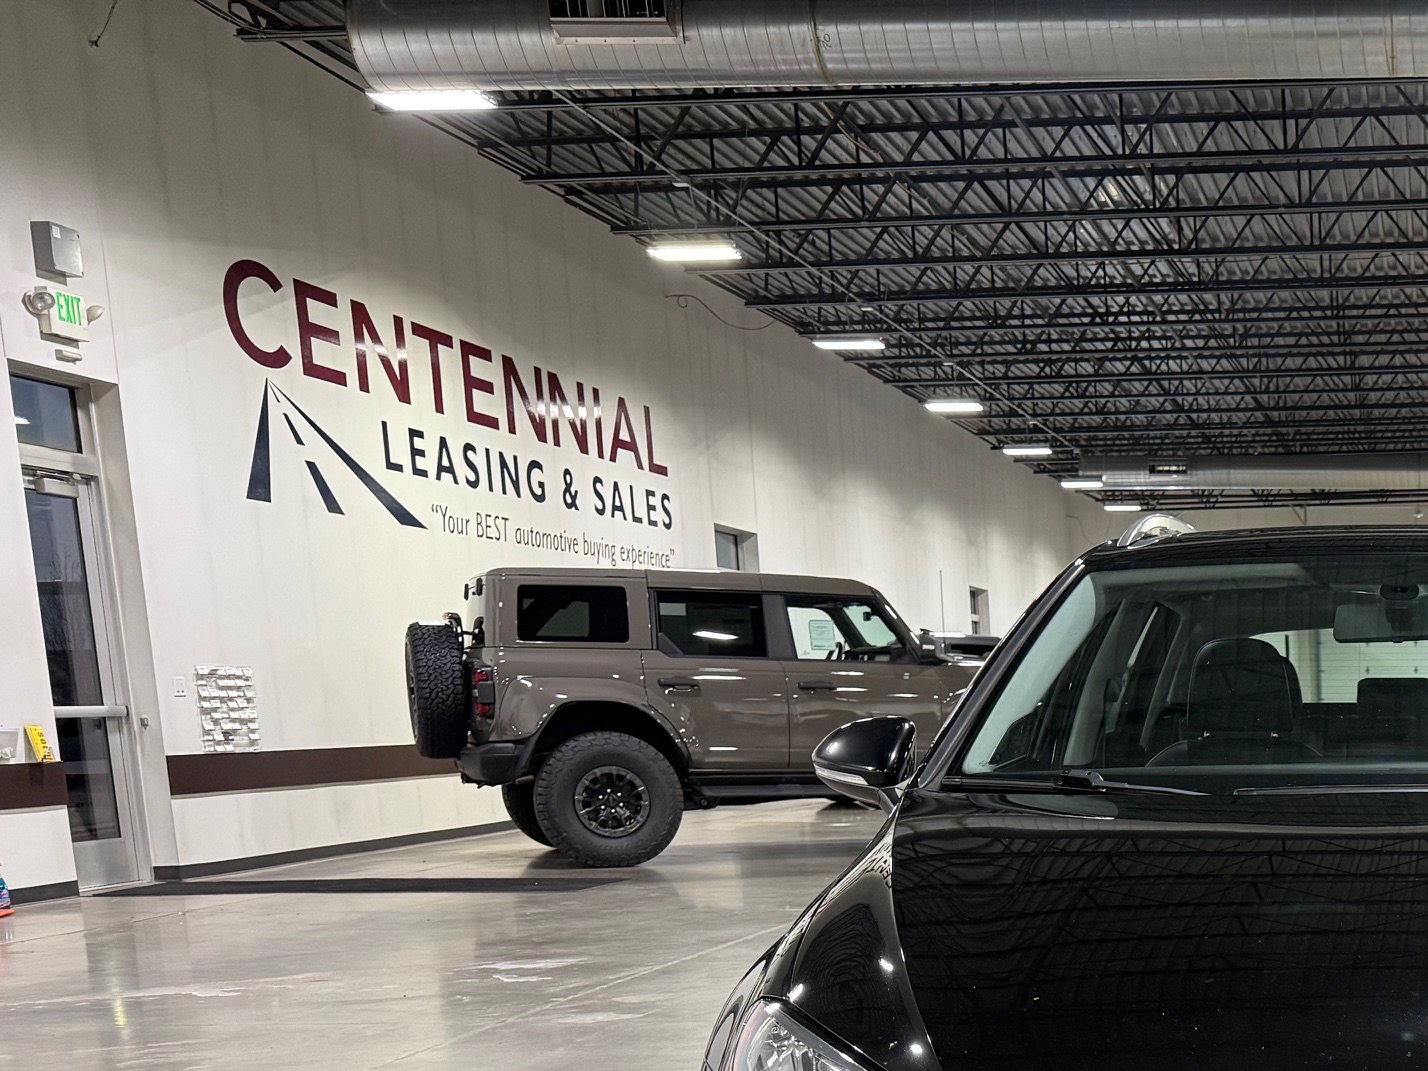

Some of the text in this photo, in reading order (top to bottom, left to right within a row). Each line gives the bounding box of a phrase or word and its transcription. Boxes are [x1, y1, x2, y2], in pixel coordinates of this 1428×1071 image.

[55, 291, 83, 326] EXIT
[222, 259, 669, 477] CENTENNIAL
[381, 420, 673, 530] LEASING & SALES
[476, 512, 509, 543] BEST
[514, 528, 579, 555] automotive
[583, 532, 616, 567] buying
